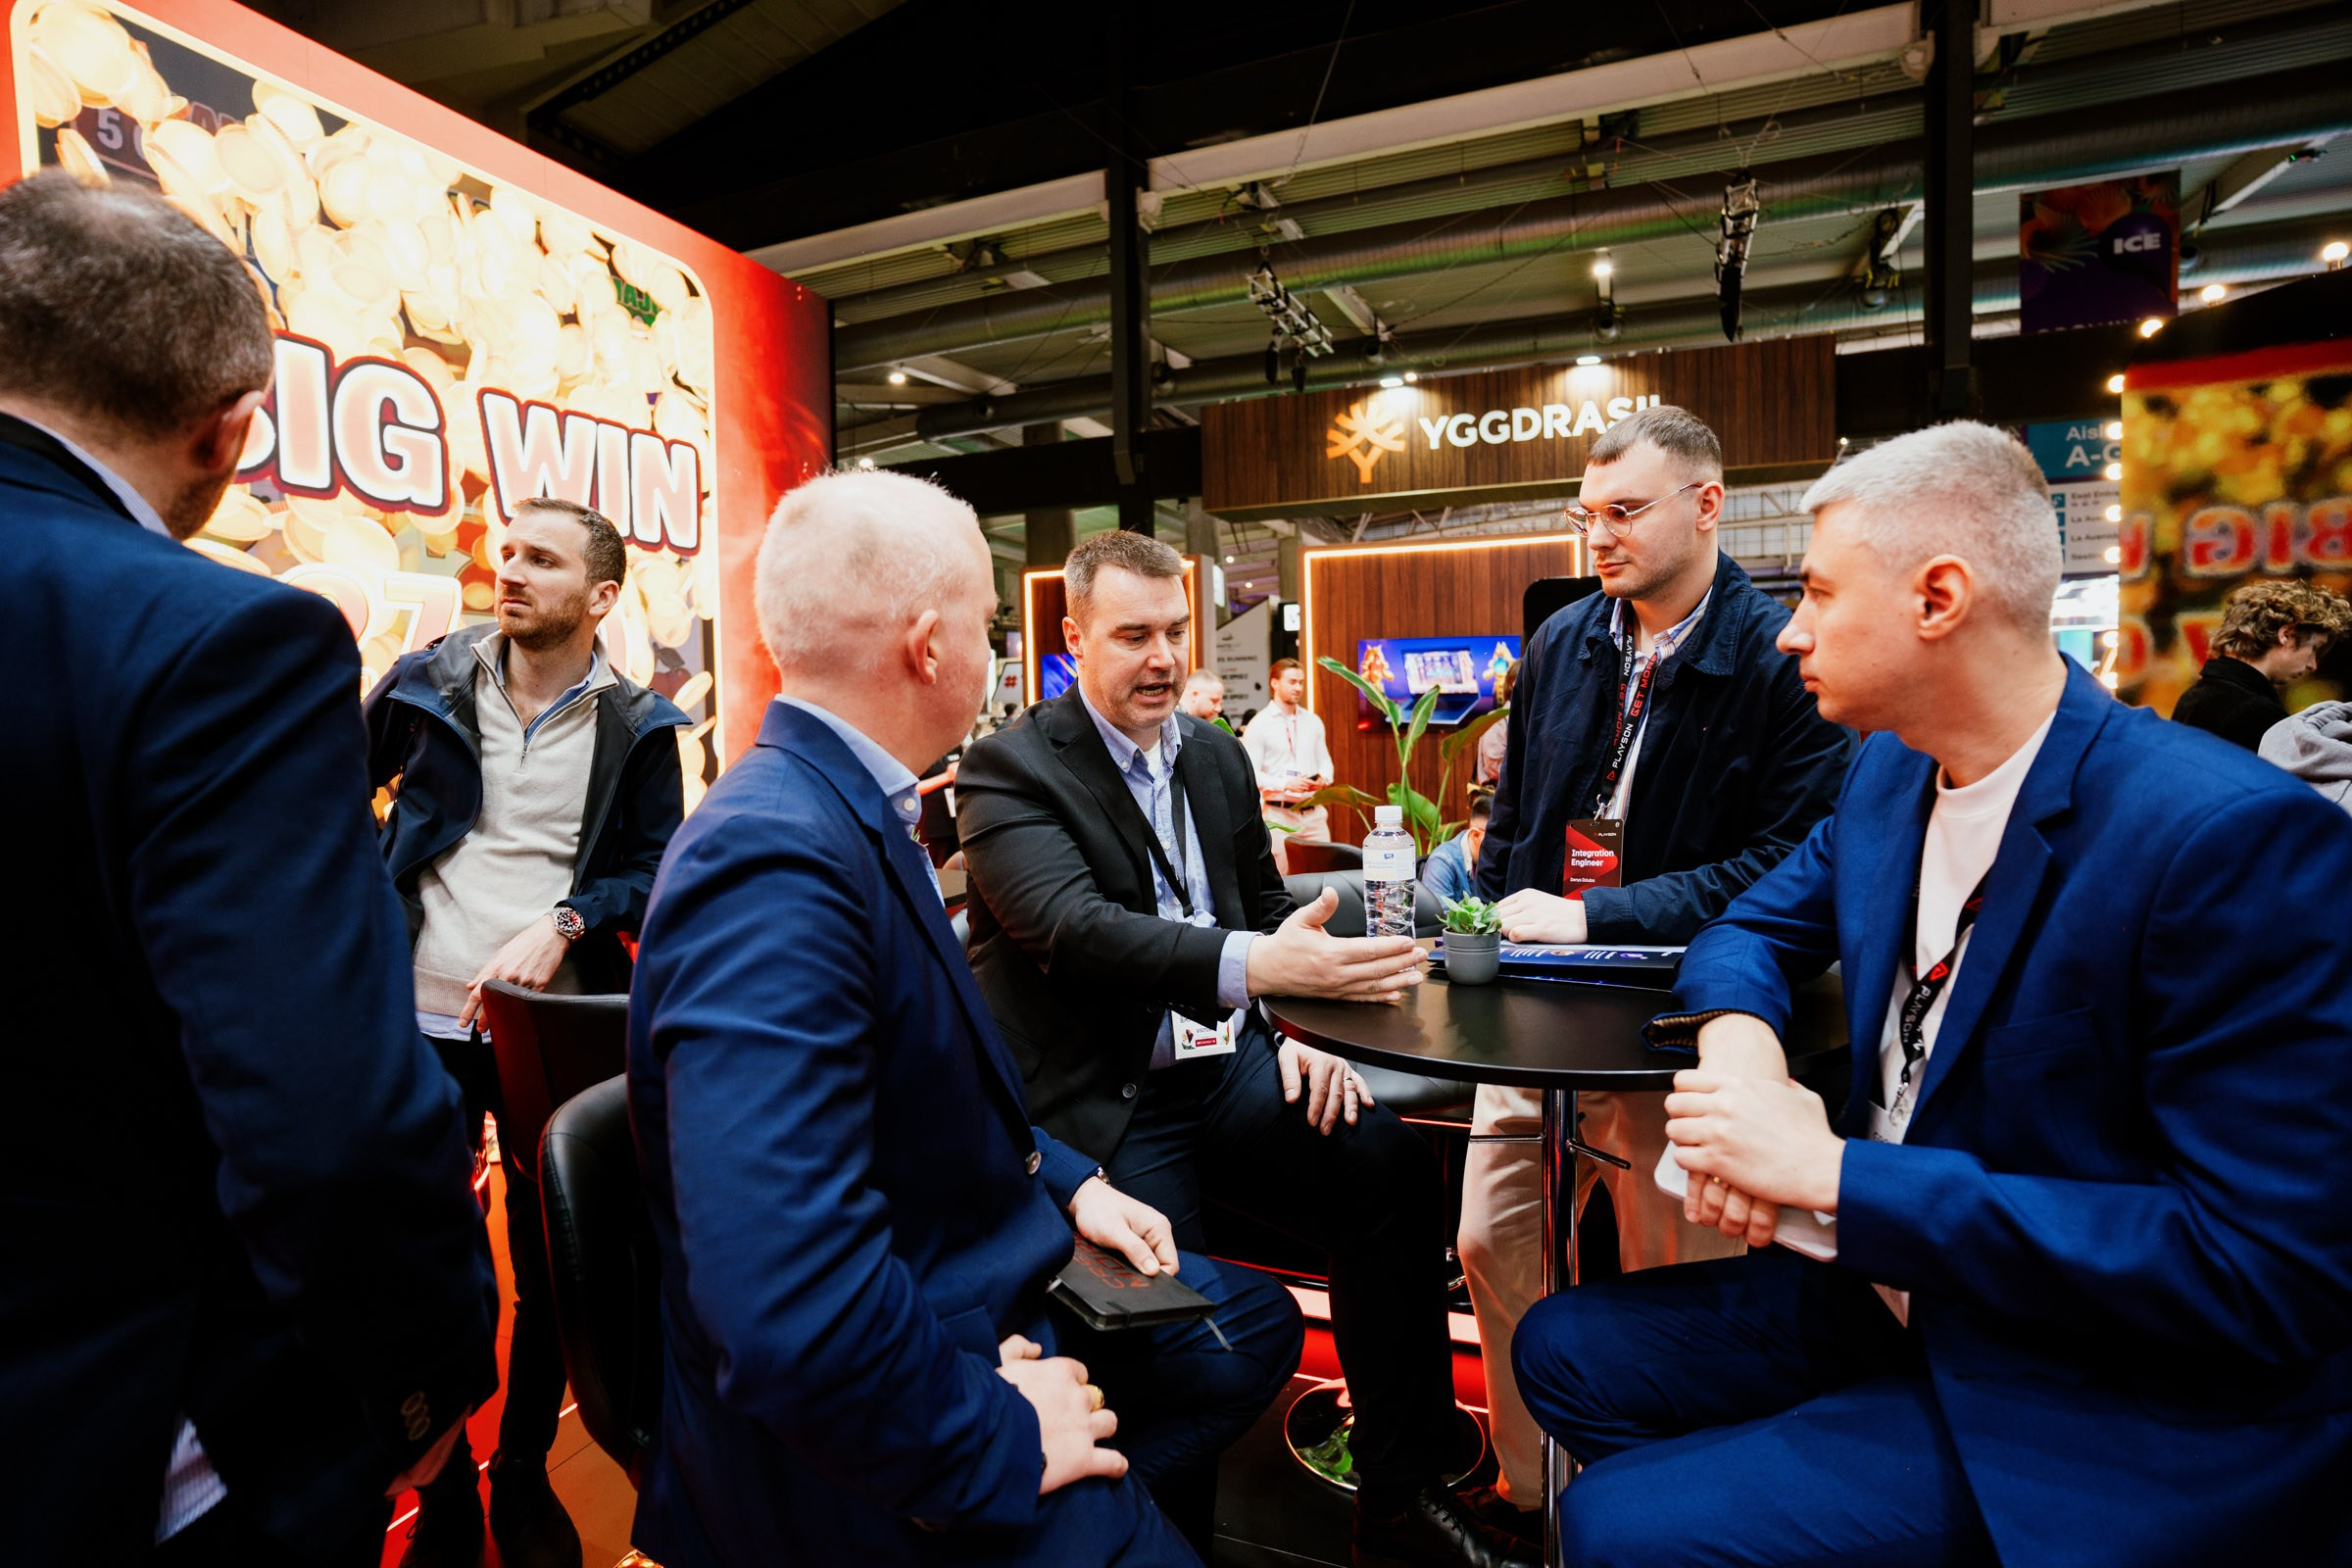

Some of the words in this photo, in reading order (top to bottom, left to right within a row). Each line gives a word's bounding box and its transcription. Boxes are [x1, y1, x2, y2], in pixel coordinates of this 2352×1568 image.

[2113, 232, 2162, 255] ICE
[235, 334, 449, 512] IG
[478, 389, 700, 555] WIN
[2066, 423, 2107, 441] Aisl
[1623, 634, 1634, 676] PLAYSON
[1611, 723, 1634, 768] PLAYSON
[1630, 691, 1645, 717] GET
[1571, 849, 1615, 858] Integration
[1571, 858, 1604, 867] Engineer
[1902, 985, 1932, 1044] PLAYSON
